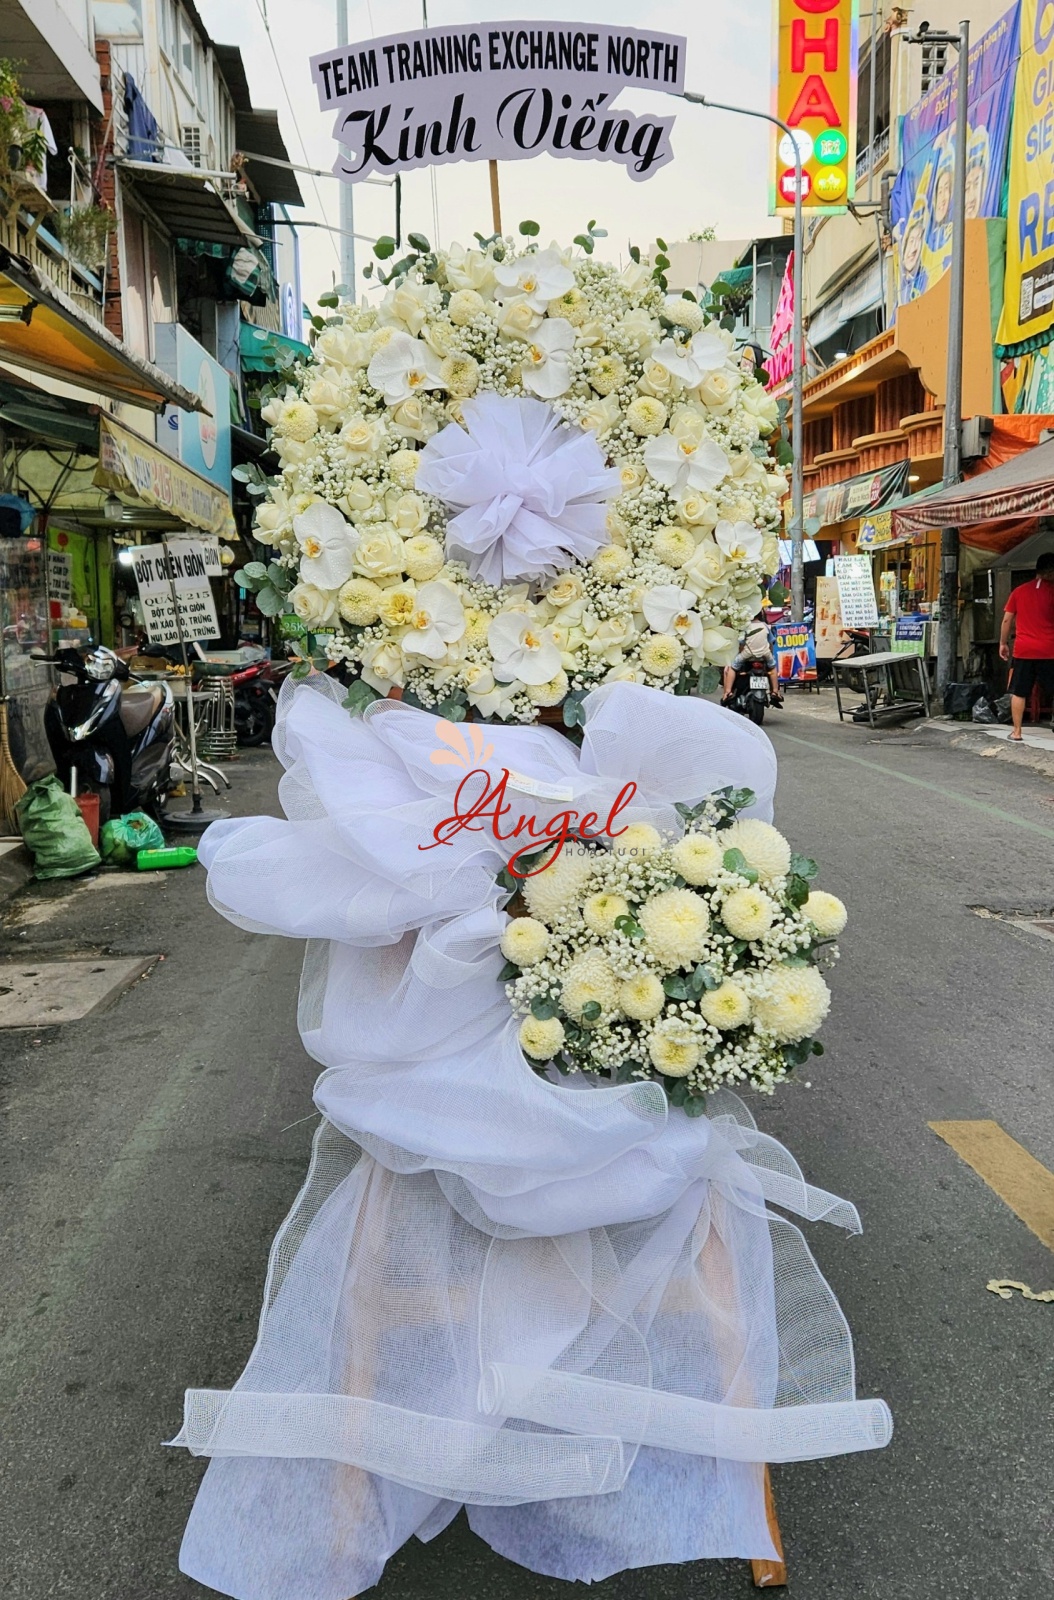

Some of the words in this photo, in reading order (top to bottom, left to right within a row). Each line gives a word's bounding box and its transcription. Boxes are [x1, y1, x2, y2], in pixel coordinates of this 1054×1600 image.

[318, 49, 379, 100] TEAM
[382, 33, 482, 84] TRAINING
[489, 30, 599, 71] EXCHANGE
[607, 36, 679, 83] NORTH
[1033, 59, 1054, 107] GI
[341, 93, 482, 174] Kính
[496, 87, 666, 173] Viếng
[1026, 101, 1054, 162] SIÊ
[135, 554, 154, 587] BỘT
[155, 550, 184, 581] CHÊN
[184, 548, 206, 577] GIÒN
[151, 606, 165, 618] BỘT
[166, 604, 188, 616] CHÊN
[189, 602, 206, 612] GIÒN
[187, 591, 210, 600] 215
[149, 620, 159, 631] MÌ
[160, 618, 174, 629] XÀO
[188, 614, 213, 625] TRỨNG
[150, 633, 163, 643] NUI
[164, 630, 178, 641] XÀO
[193, 626, 217, 637] TRỨNG
